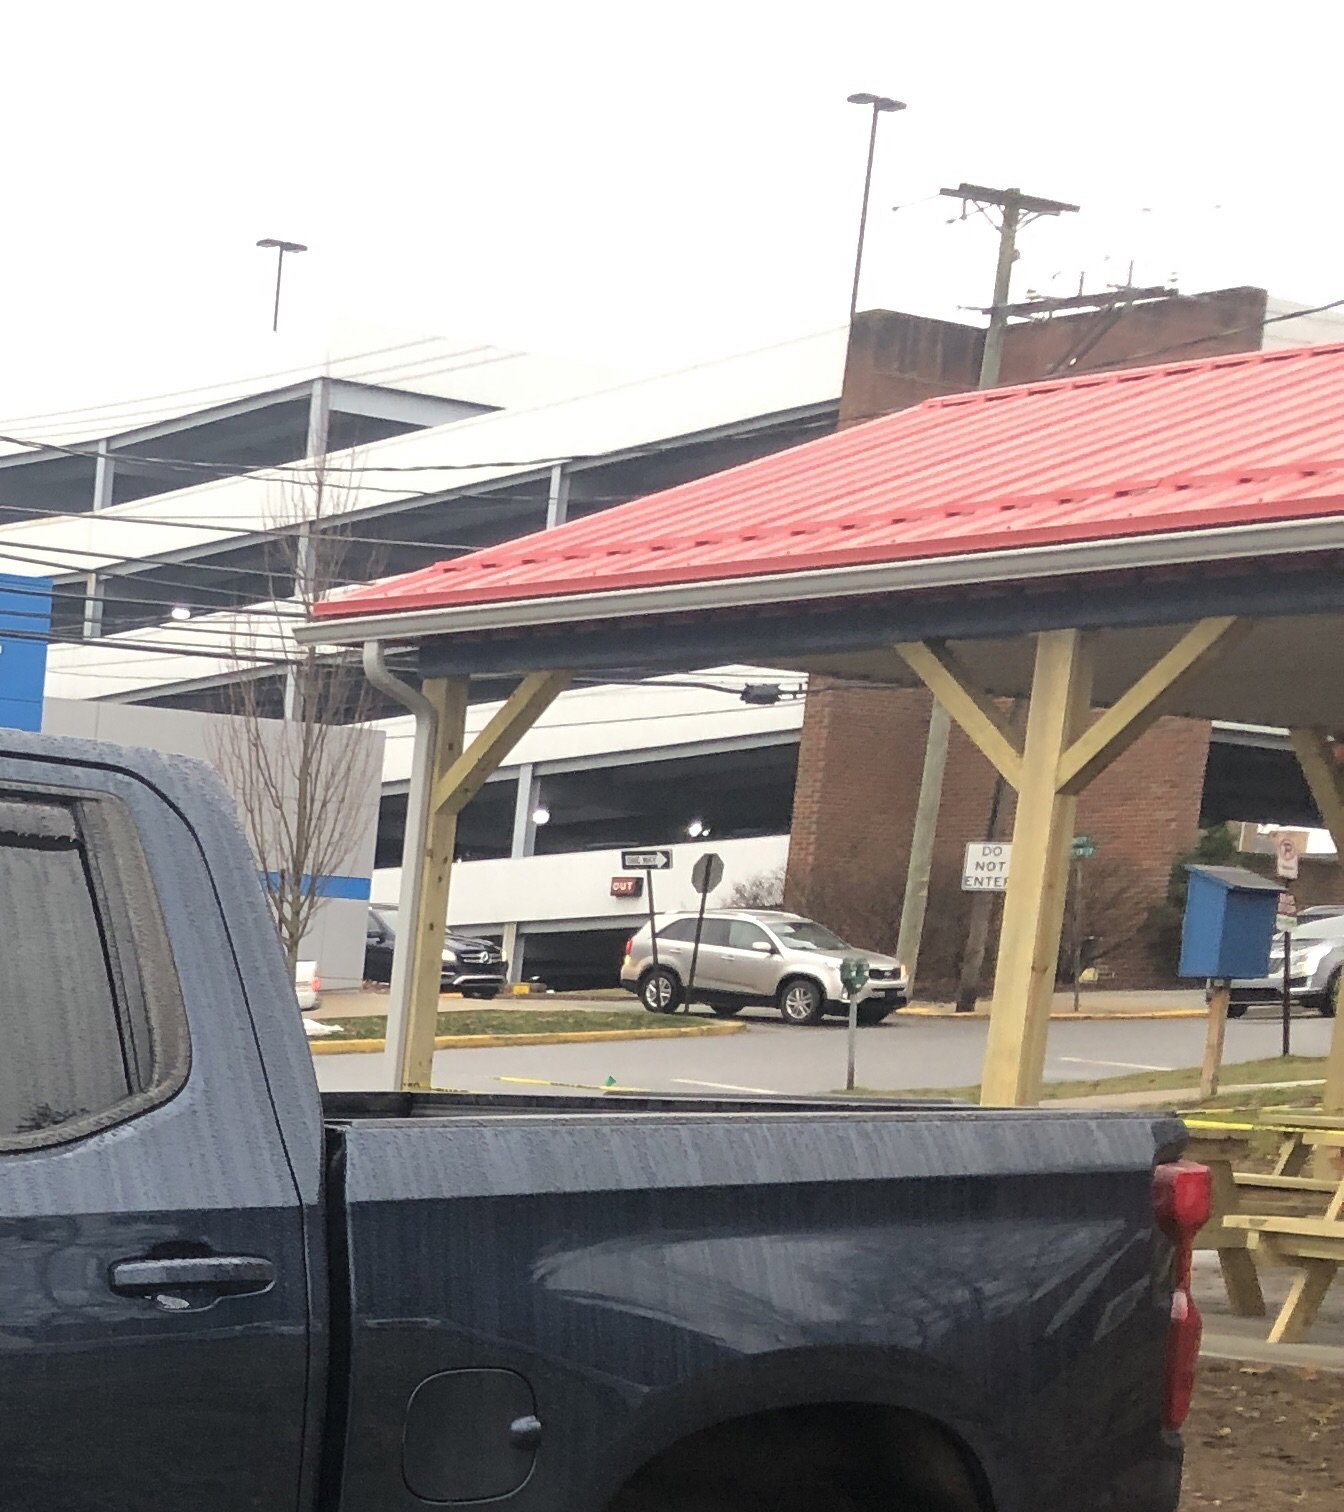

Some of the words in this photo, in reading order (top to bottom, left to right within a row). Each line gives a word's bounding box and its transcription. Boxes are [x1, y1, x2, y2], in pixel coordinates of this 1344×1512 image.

[982, 846, 1002, 856] DO
[976, 861, 1006, 871] NOT
[613, 881, 633, 891] OUT
